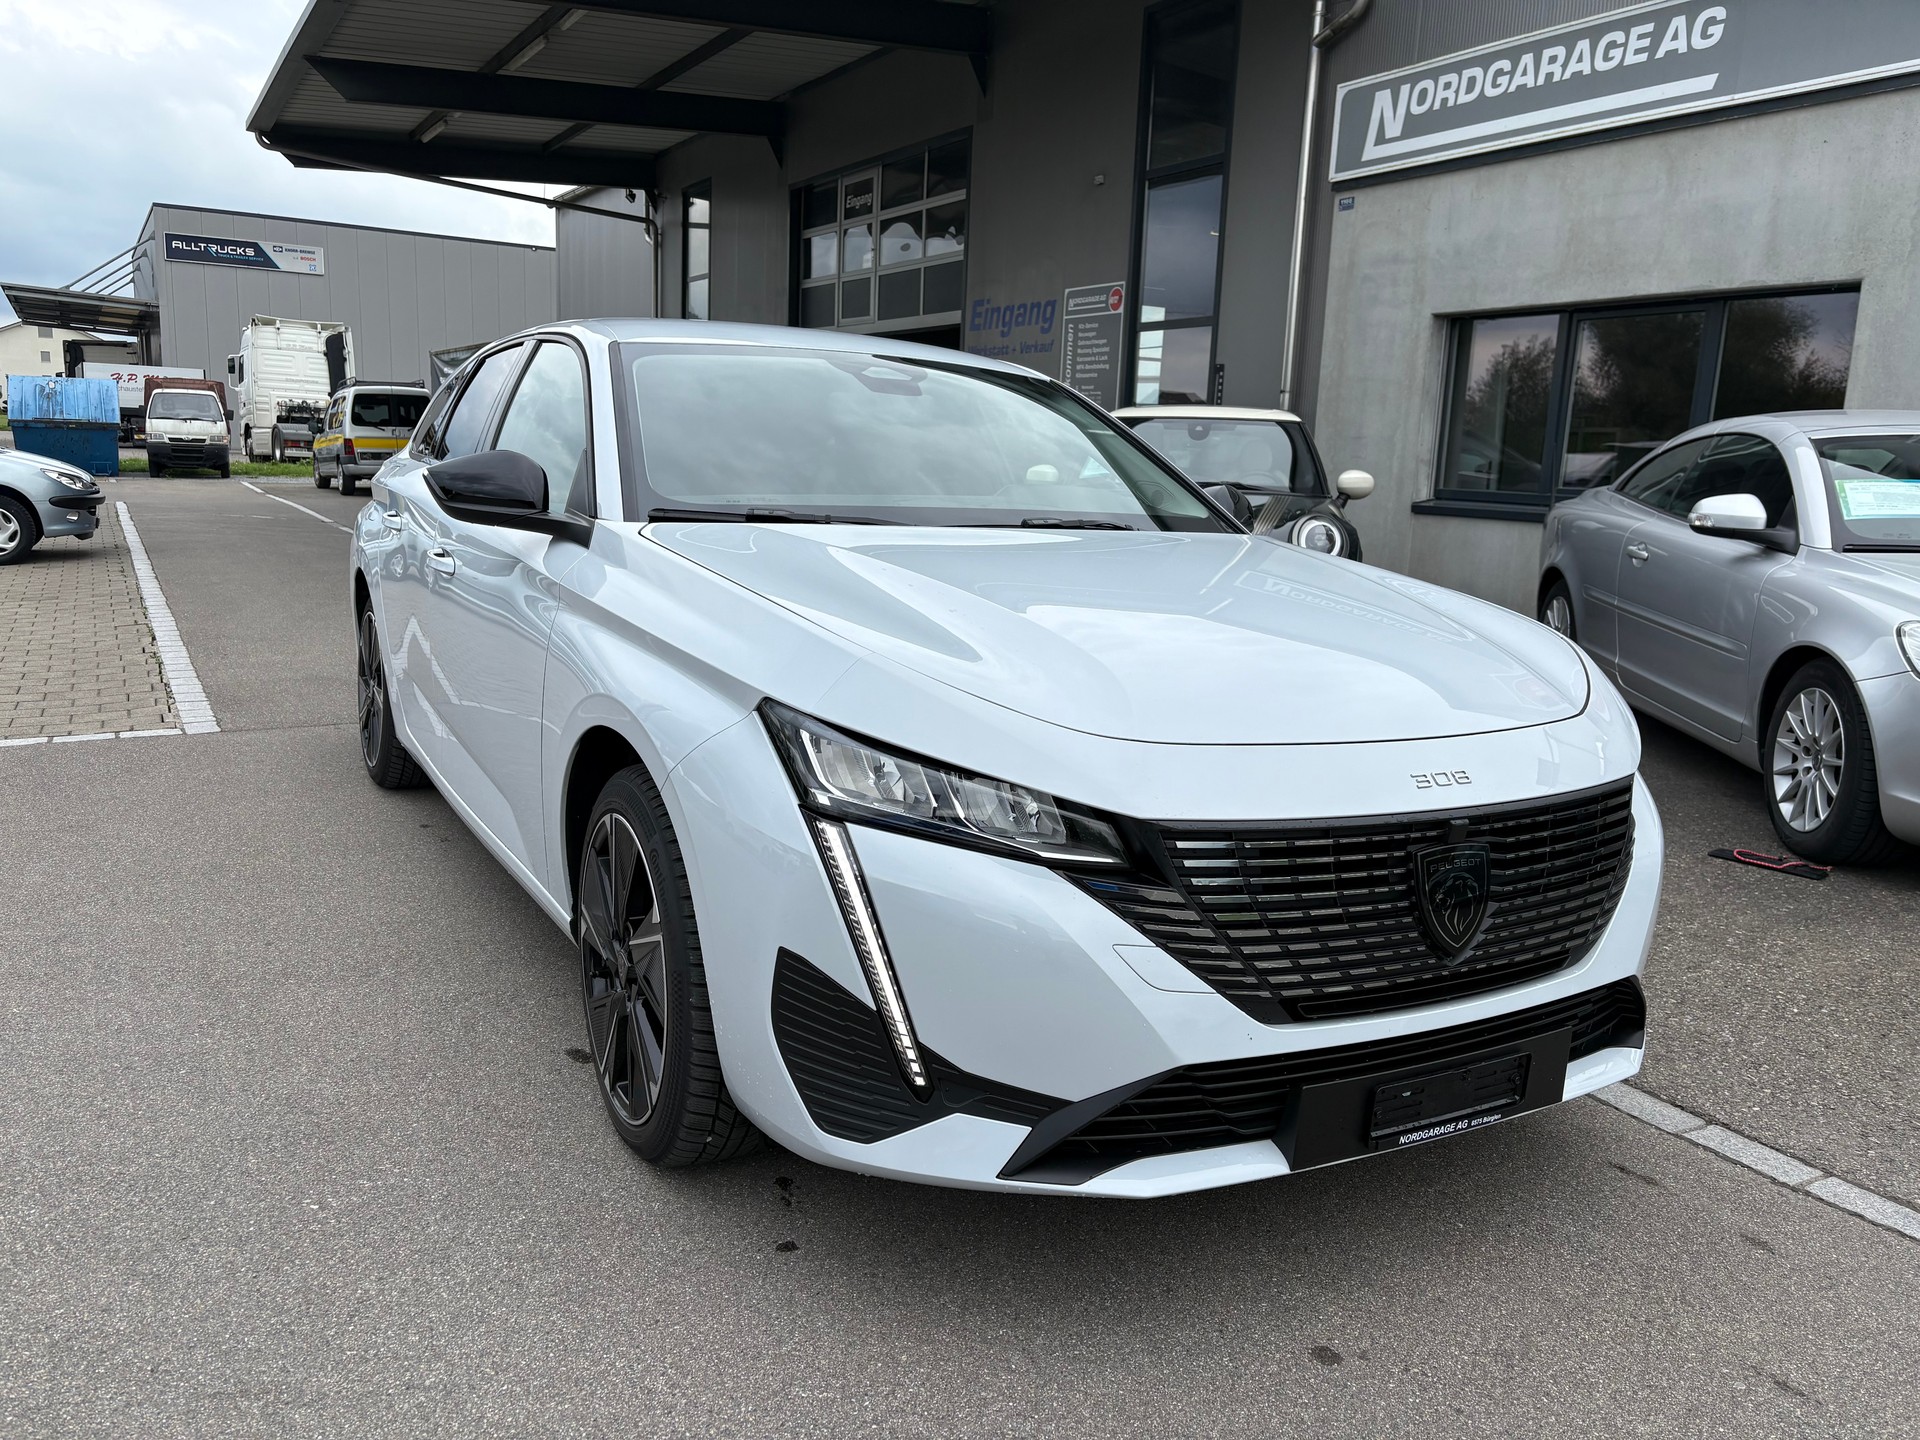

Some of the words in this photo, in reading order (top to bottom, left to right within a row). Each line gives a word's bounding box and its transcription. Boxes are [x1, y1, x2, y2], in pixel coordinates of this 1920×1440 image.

[1362, 22, 1654, 161] NORDGARAGE
[1655, 6, 1727, 58] AG
[846, 193, 872, 209] Eingang
[172, 240, 255, 256] ALLTRUCKS
[969, 299, 1057, 338] Eingang
[968, 344, 1009, 357] Werkstatt
[1020, 339, 1055, 354] Verkauf
[1410, 770, 1472, 789] 308
[1430, 858, 1481, 873] PEUGEOT
[1398, 1122, 1456, 1144] NORDGARAGE
[1456, 1119, 1469, 1131] AG
